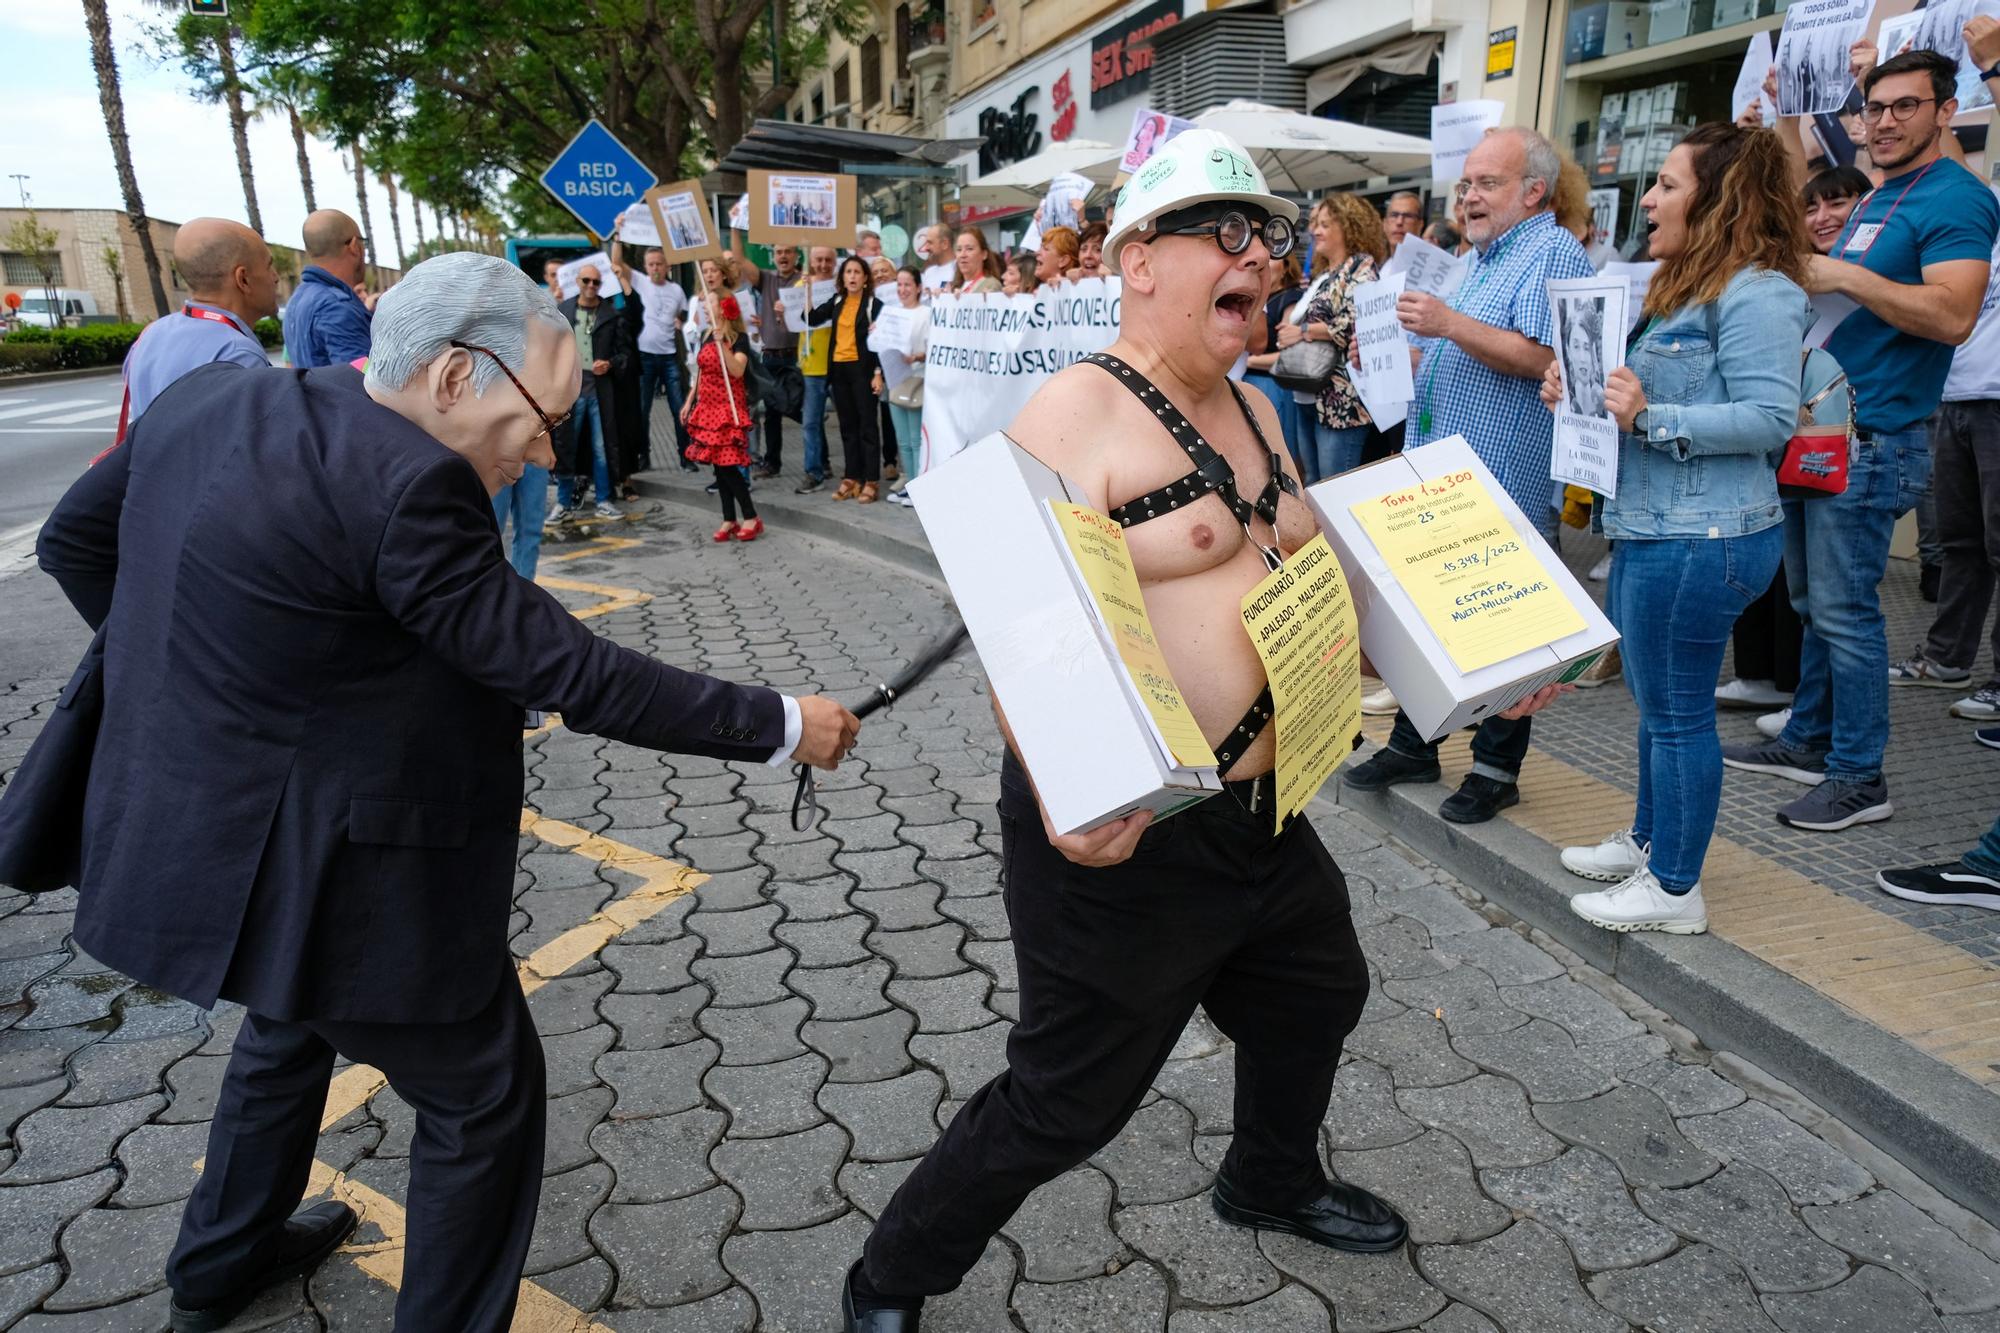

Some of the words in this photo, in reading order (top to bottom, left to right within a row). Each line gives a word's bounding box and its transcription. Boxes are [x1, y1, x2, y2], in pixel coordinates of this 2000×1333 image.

[1803, 2, 1827, 14] TODOS
[1792, 18, 1816, 32] COMITÉ
[1816, 17, 1827, 28] DE
[1826, 12, 1852, 25] HUELGA
[1091, 39, 1123, 93] SEX
[579, 163, 617, 178] RED
[1219, 175, 1250, 183] CURRITO
[565, 181, 635, 197] BASICA
[1363, 292, 1397, 317] JUSTICIA
[1358, 321, 1399, 347] EGOCIACIÓN
[1371, 356, 1382, 372] YA
[1580, 434, 1600, 448] SERIAS
[1568, 449, 1578, 460] LA
[1580, 451, 1606, 468] MINISTRA
[1421, 484, 1429, 496] 1
[1443, 471, 1473, 488] 300
[1573, 467, 1582, 477] DE
[1584, 468, 1600, 480] FERIA
[1386, 507, 1416, 521] Juzgado
[1416, 503, 1427, 512] de
[1426, 491, 1465, 509] Instrucción
[1387, 519, 1417, 533] Número
[1417, 511, 1435, 524] 25
[1439, 509, 1450, 517] de
[1450, 499, 1478, 514] Málaga
[1405, 541, 1460, 565] DILIGENCIAS
[1462, 528, 1500, 545] PREVIAS
[1243, 573, 1295, 624] FUNCIONARIO
[1293, 545, 1328, 579] JUDICIAL
[1455, 581, 1513, 606] ESTAFAS
[1260, 605, 1295, 643] APALEADO
[1298, 567, 1336, 607] MALPAGADO
[1267, 621, 1303, 659] HUMILLADO
[1305, 583, 1340, 622] NINGUNEADO
[1273, 648, 1298, 677] TRABAJANDO
[1278, 659, 1306, 690] GESTIONANDO
[1306, 639, 1325, 661] MILLONES
[1280, 773, 1299, 800] HUELGA
